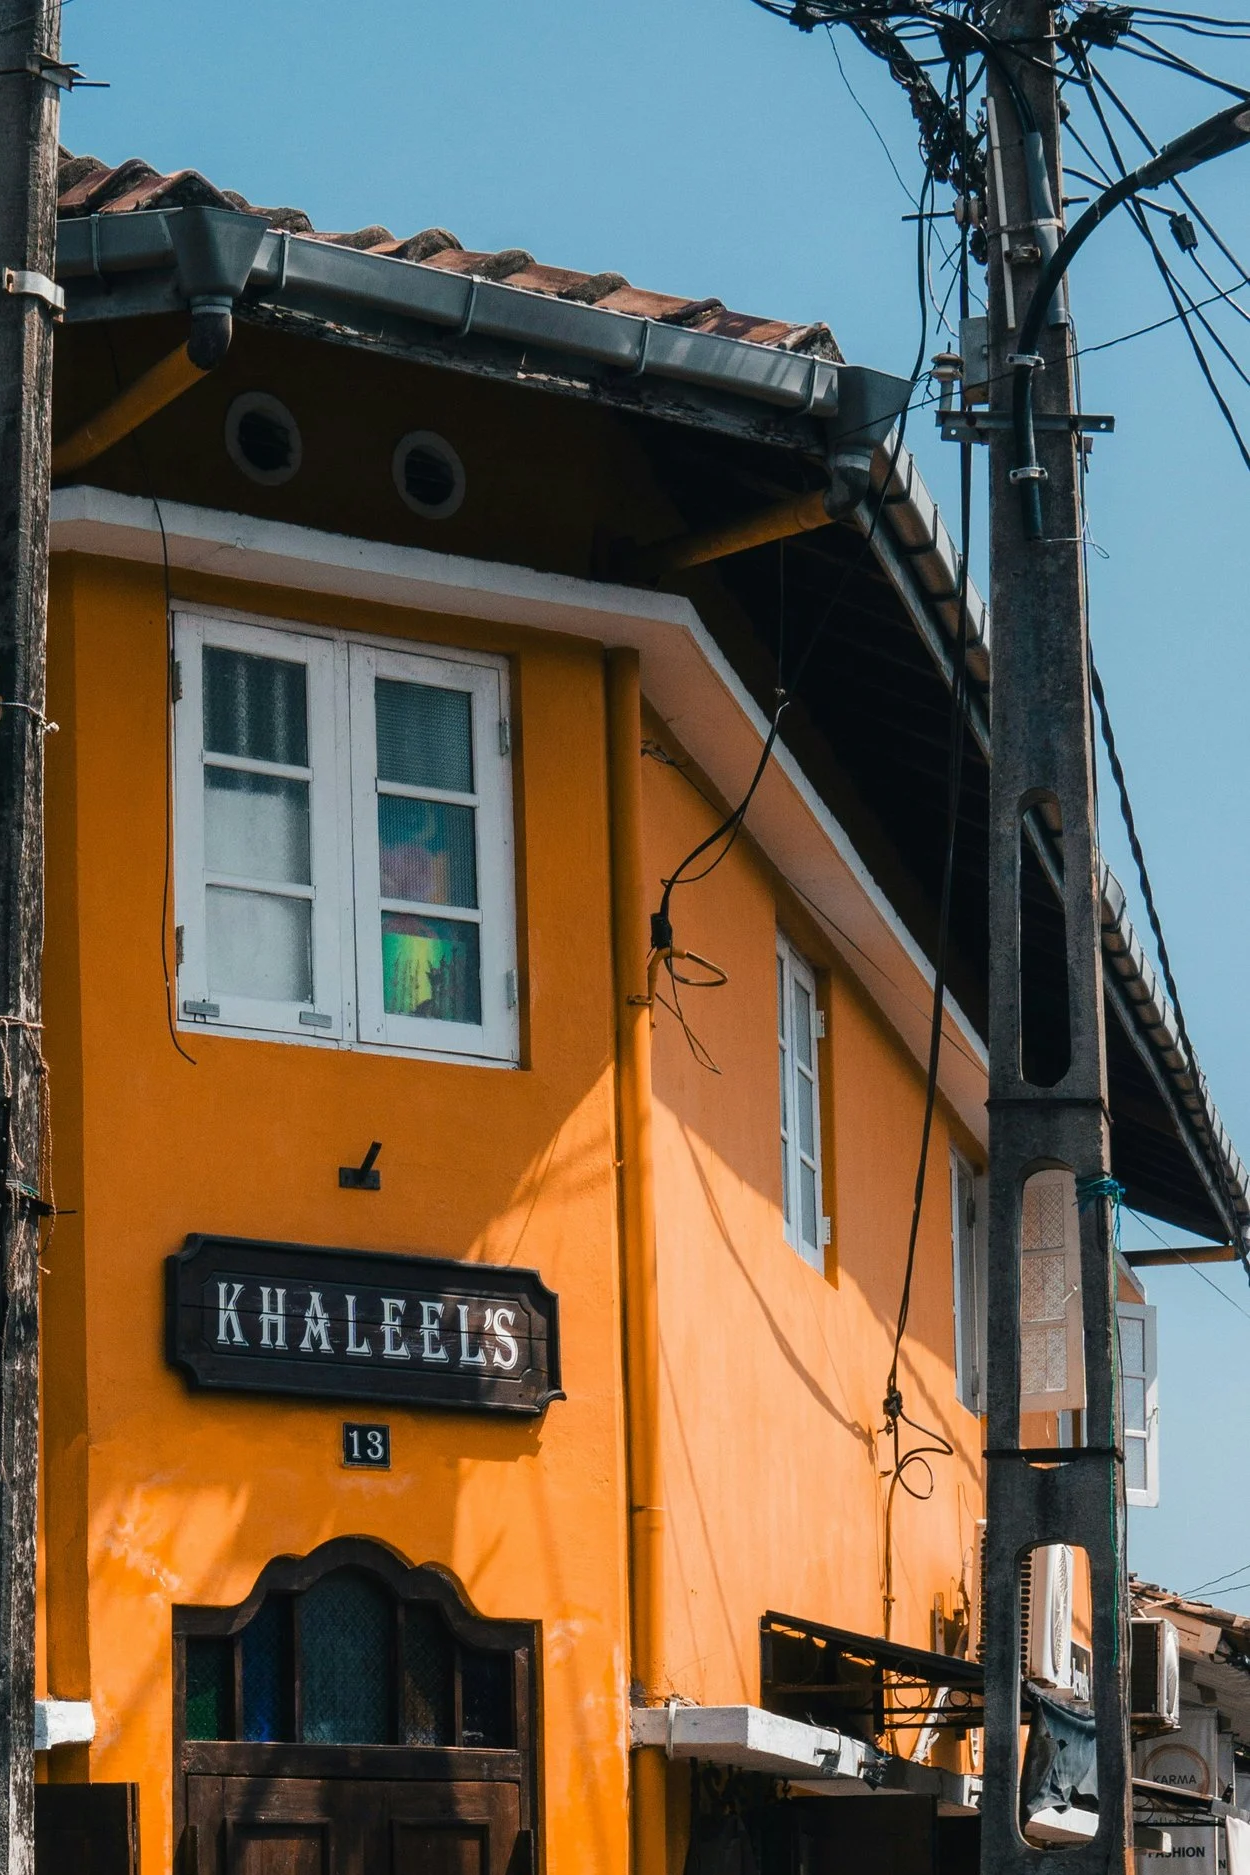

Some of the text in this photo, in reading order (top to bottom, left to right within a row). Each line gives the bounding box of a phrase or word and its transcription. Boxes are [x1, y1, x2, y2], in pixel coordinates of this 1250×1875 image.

[216, 1281, 517, 1371] KHALEEL'S
[349, 1430, 384, 1461] 13
[1152, 1774, 1197, 1785] KARMA
